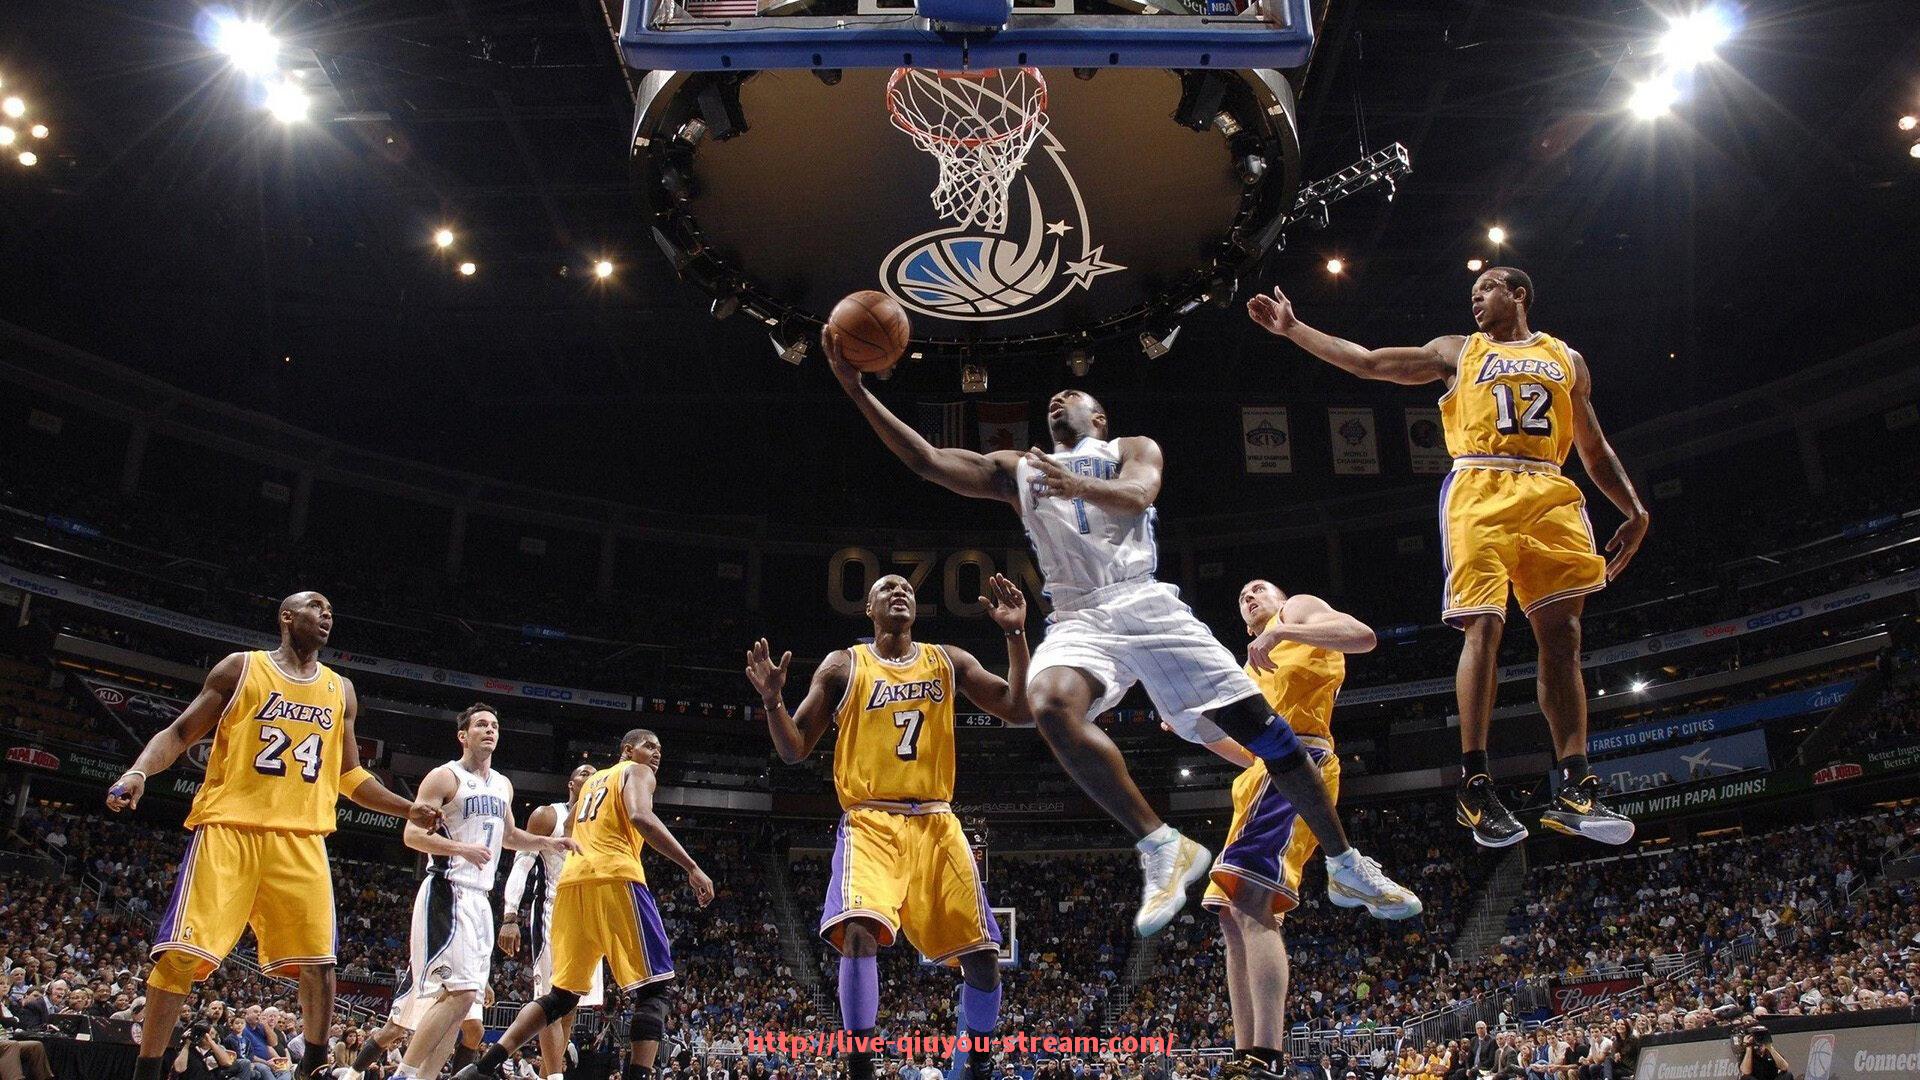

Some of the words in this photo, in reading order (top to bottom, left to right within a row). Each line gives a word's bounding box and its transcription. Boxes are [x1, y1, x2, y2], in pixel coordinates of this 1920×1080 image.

[1211, 2, 1233, 13] NBA
[1474, 353, 1565, 384] LAKERS
[1492, 383, 1553, 437] 12
[9, 576, 58, 596] PEPSICO
[1823, 592, 1871, 610] PEPSICO
[1747, 607, 1803, 630] GEICO
[1505, 665, 1537, 678] Amway
[98, 690, 120, 703] KIA
[521, 685, 573, 701] GEICO
[865, 679, 944, 706] LAKERS
[255, 691, 334, 730] LAKERS
[588, 696, 628, 709] PEPSICO
[966, 714, 992, 726] 4:52
[1148, 710, 1155, 721] 4
[893, 709, 925, 761] 7
[1593, 736, 1622, 751] FARES
[1624, 733, 1637, 745] TO
[1639, 728, 1665, 743] OVER
[1682, 718, 1716, 736] CITIES
[70, 752, 97, 767] Better
[254, 724, 324, 784] 24
[80, 765, 106, 781] Better
[577, 786, 609, 822] 17
[1618, 802, 1645, 816] WIN
[1650, 794, 1681, 813] WITH
[1684, 788, 1717, 806] PAPA
[1720, 778, 1767, 800] JOHNS!
[355, 810, 400, 829] JOHNS!
[483, 821, 494, 849] 7
[1658, 1060, 1699, 1079] Connect
[1700, 1061, 1713, 1078] at
